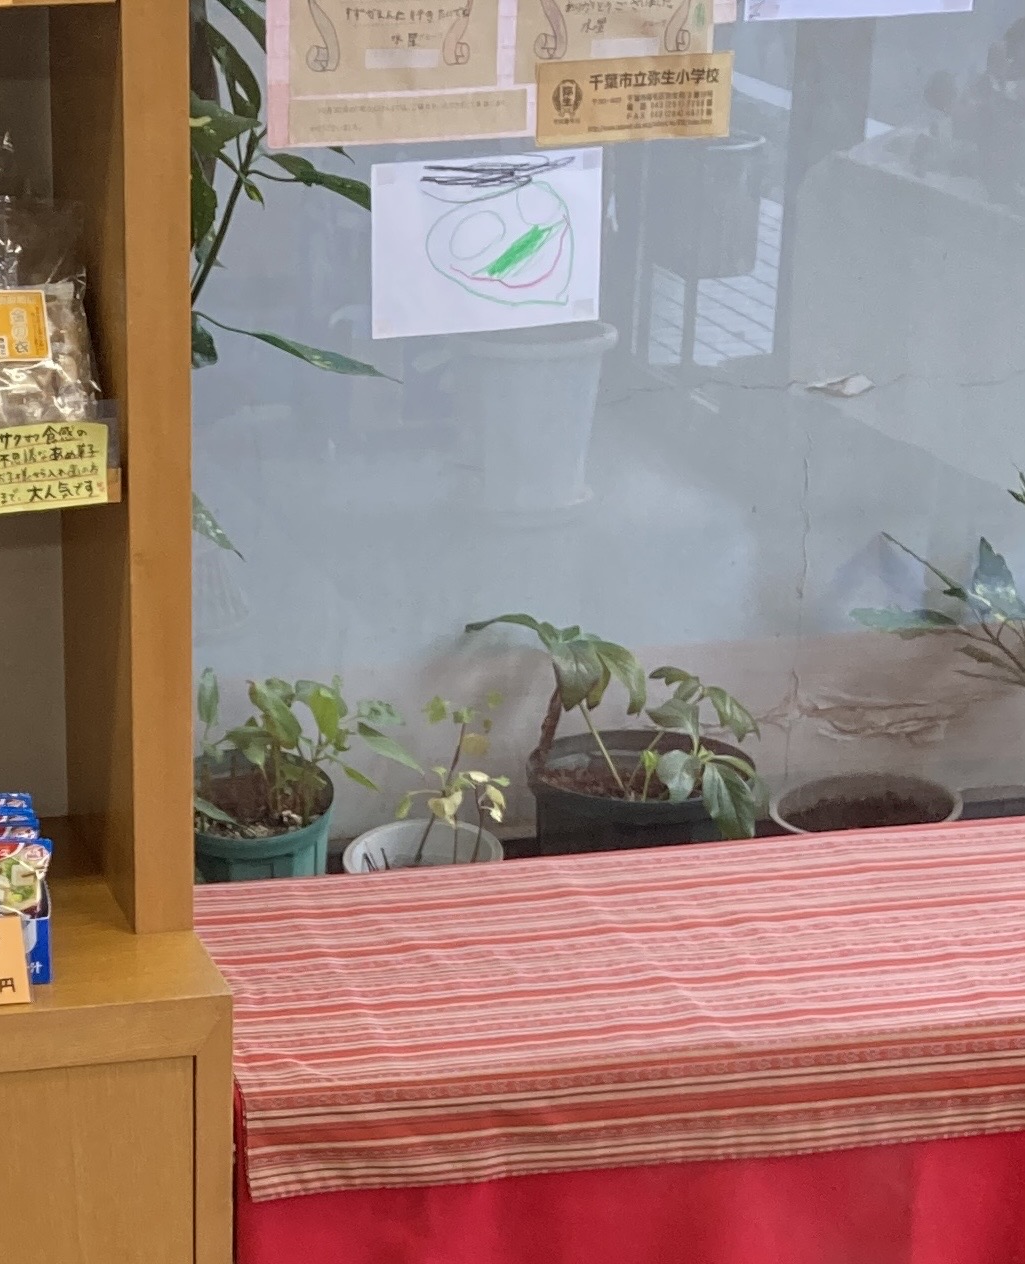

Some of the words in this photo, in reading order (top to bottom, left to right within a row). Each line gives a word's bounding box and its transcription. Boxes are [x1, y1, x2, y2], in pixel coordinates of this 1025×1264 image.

[589, 67, 720, 90] 千葉市立弥生小学校
